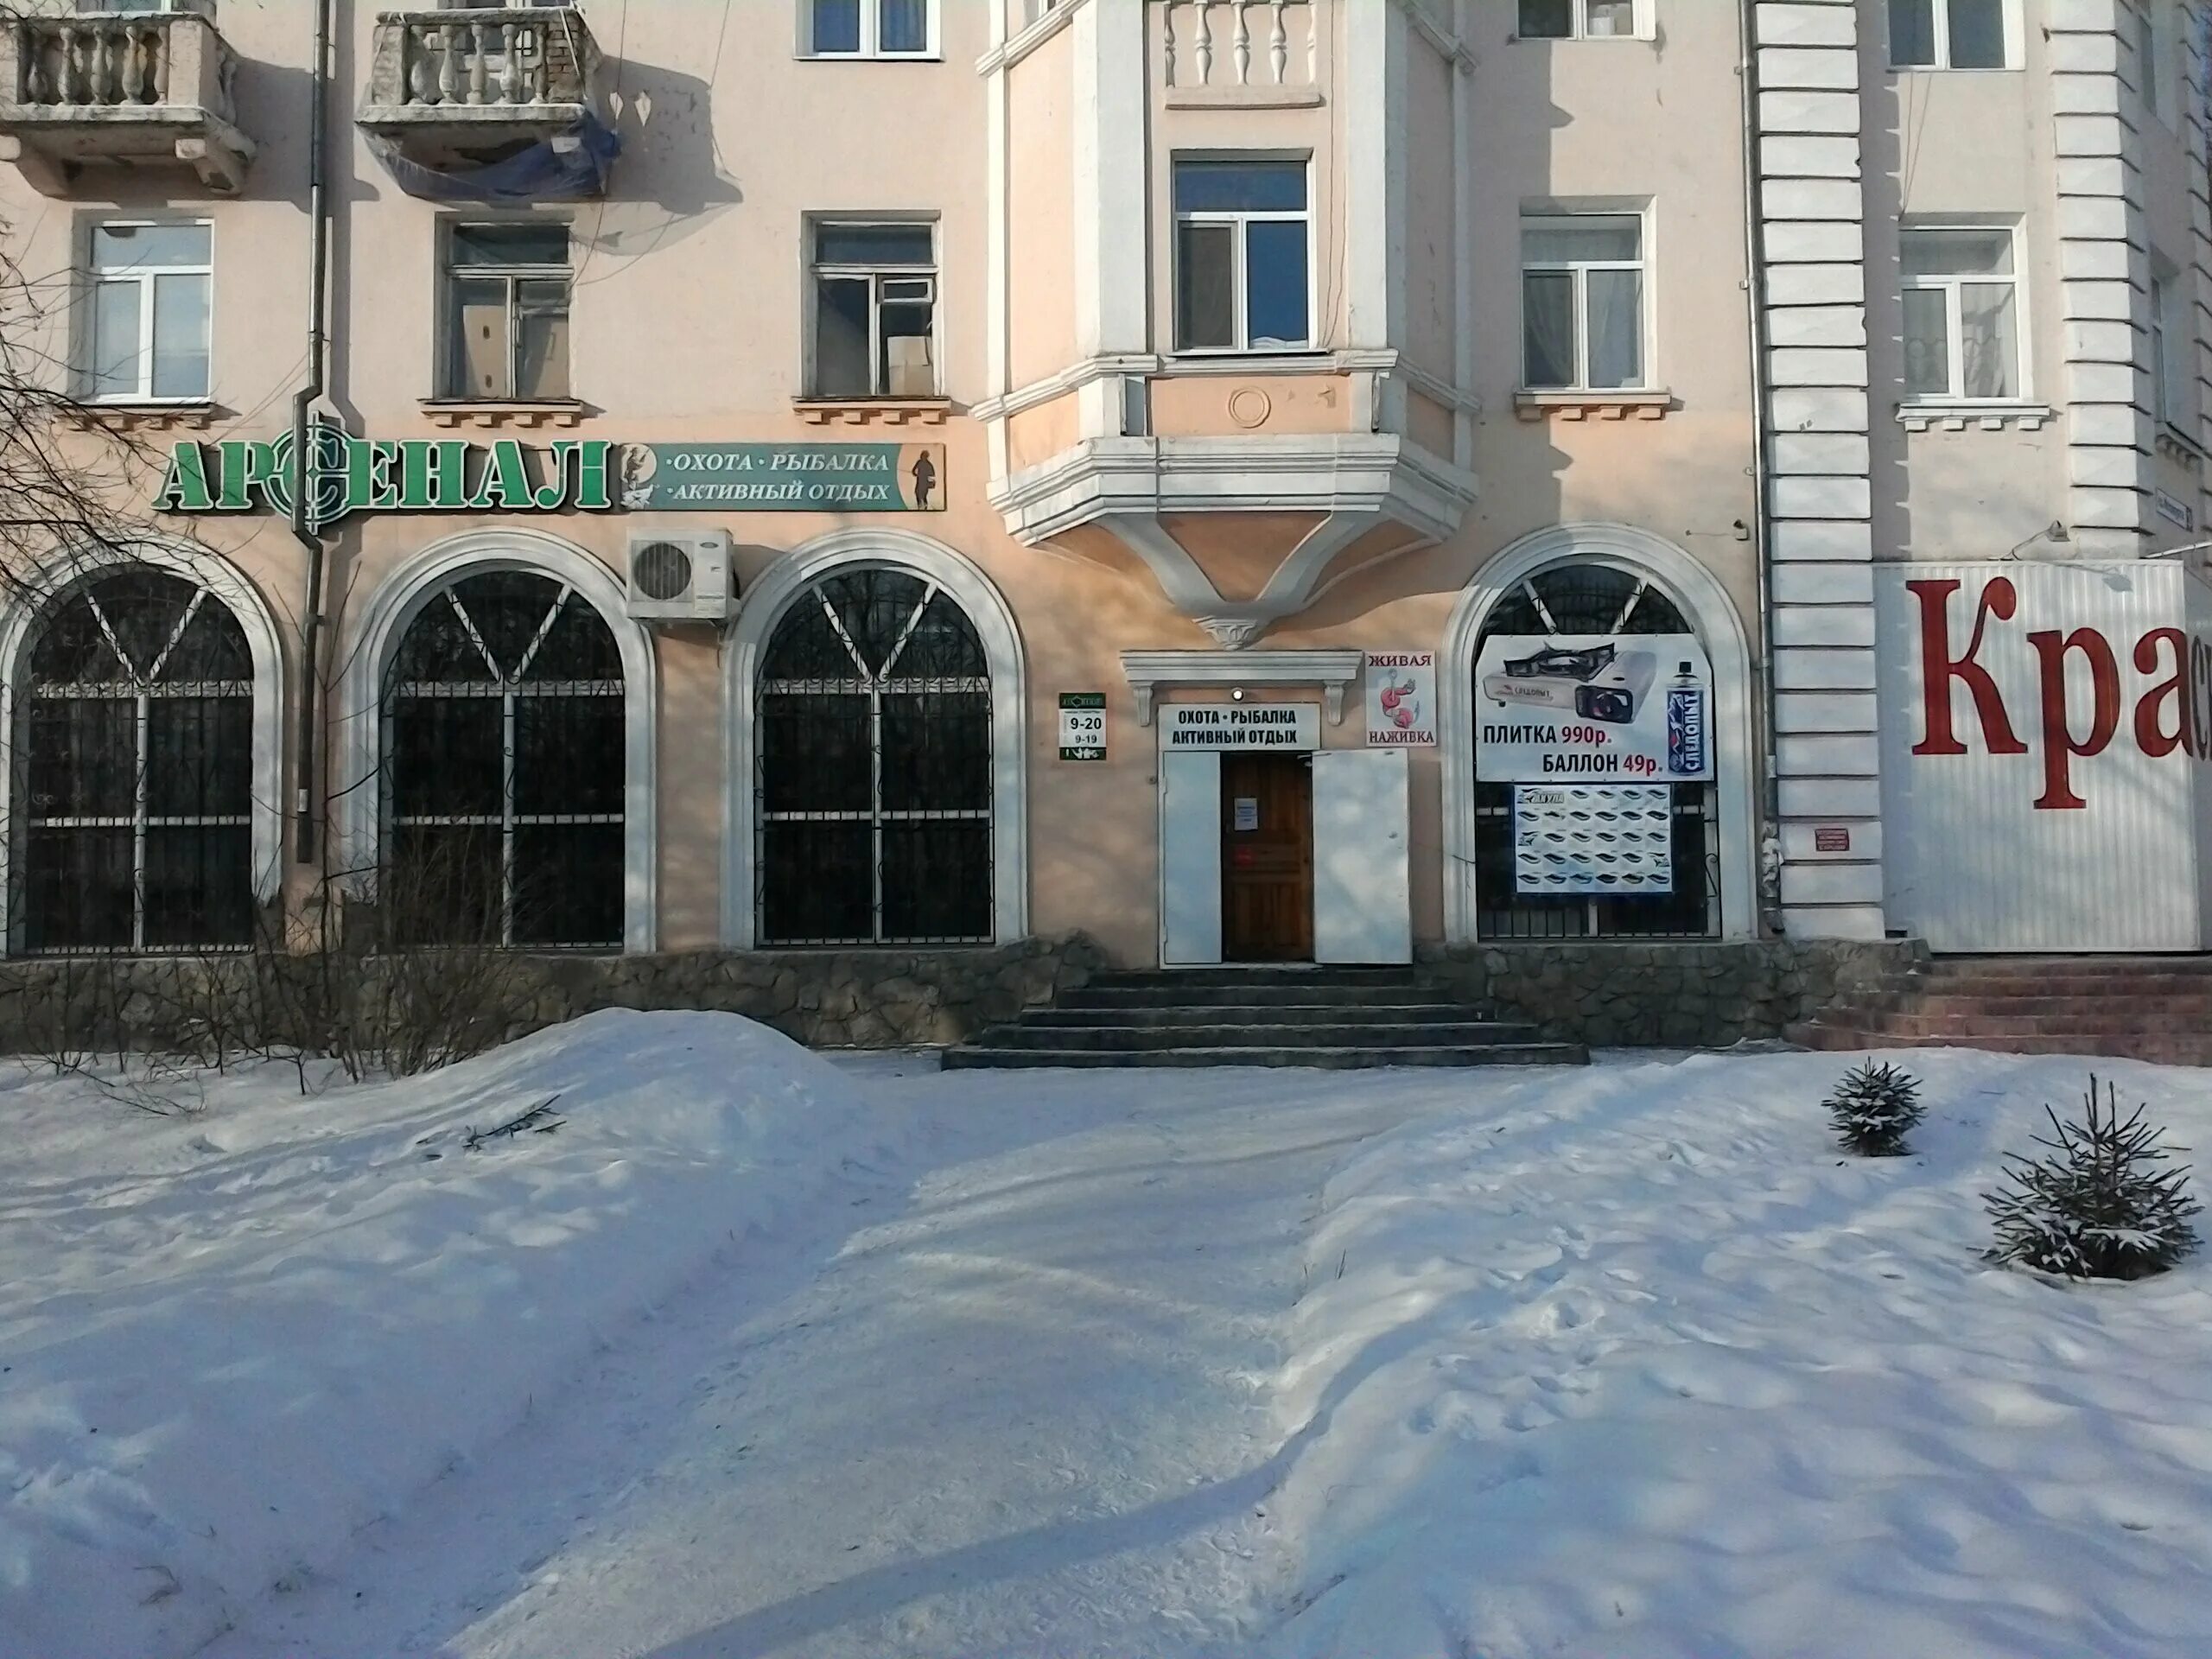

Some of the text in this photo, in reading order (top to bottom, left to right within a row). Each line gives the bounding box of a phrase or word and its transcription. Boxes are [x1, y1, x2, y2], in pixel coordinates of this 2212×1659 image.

[673, 453, 889, 472] ОХОТА РЫБАЛКА
[149, 423, 611, 524] АРСЕНАЛ
[672, 480, 891, 501] АКТИВНЫЙ ОТДЫХ
[1368, 655, 1432, 667] ЖИВАЯ
[1906, 576, 2212, 809] Крас
[1071, 717, 1102, 729] 9-20
[1179, 710, 1296, 724] ОХОТА РЫБАЛКА
[1075, 734, 1097, 744] 9-19
[1173, 728, 1298, 746] АКТИВНЫЙ ОТДЫХ
[1369, 731, 1434, 743] НАЖИВКА
[1484, 725, 1612, 748] ПЛИТКА 990р.
[1684, 693, 1700, 771] СЛЕДОПЫТ
[1542, 753, 1663, 777] БАЛЛОН 49р.
